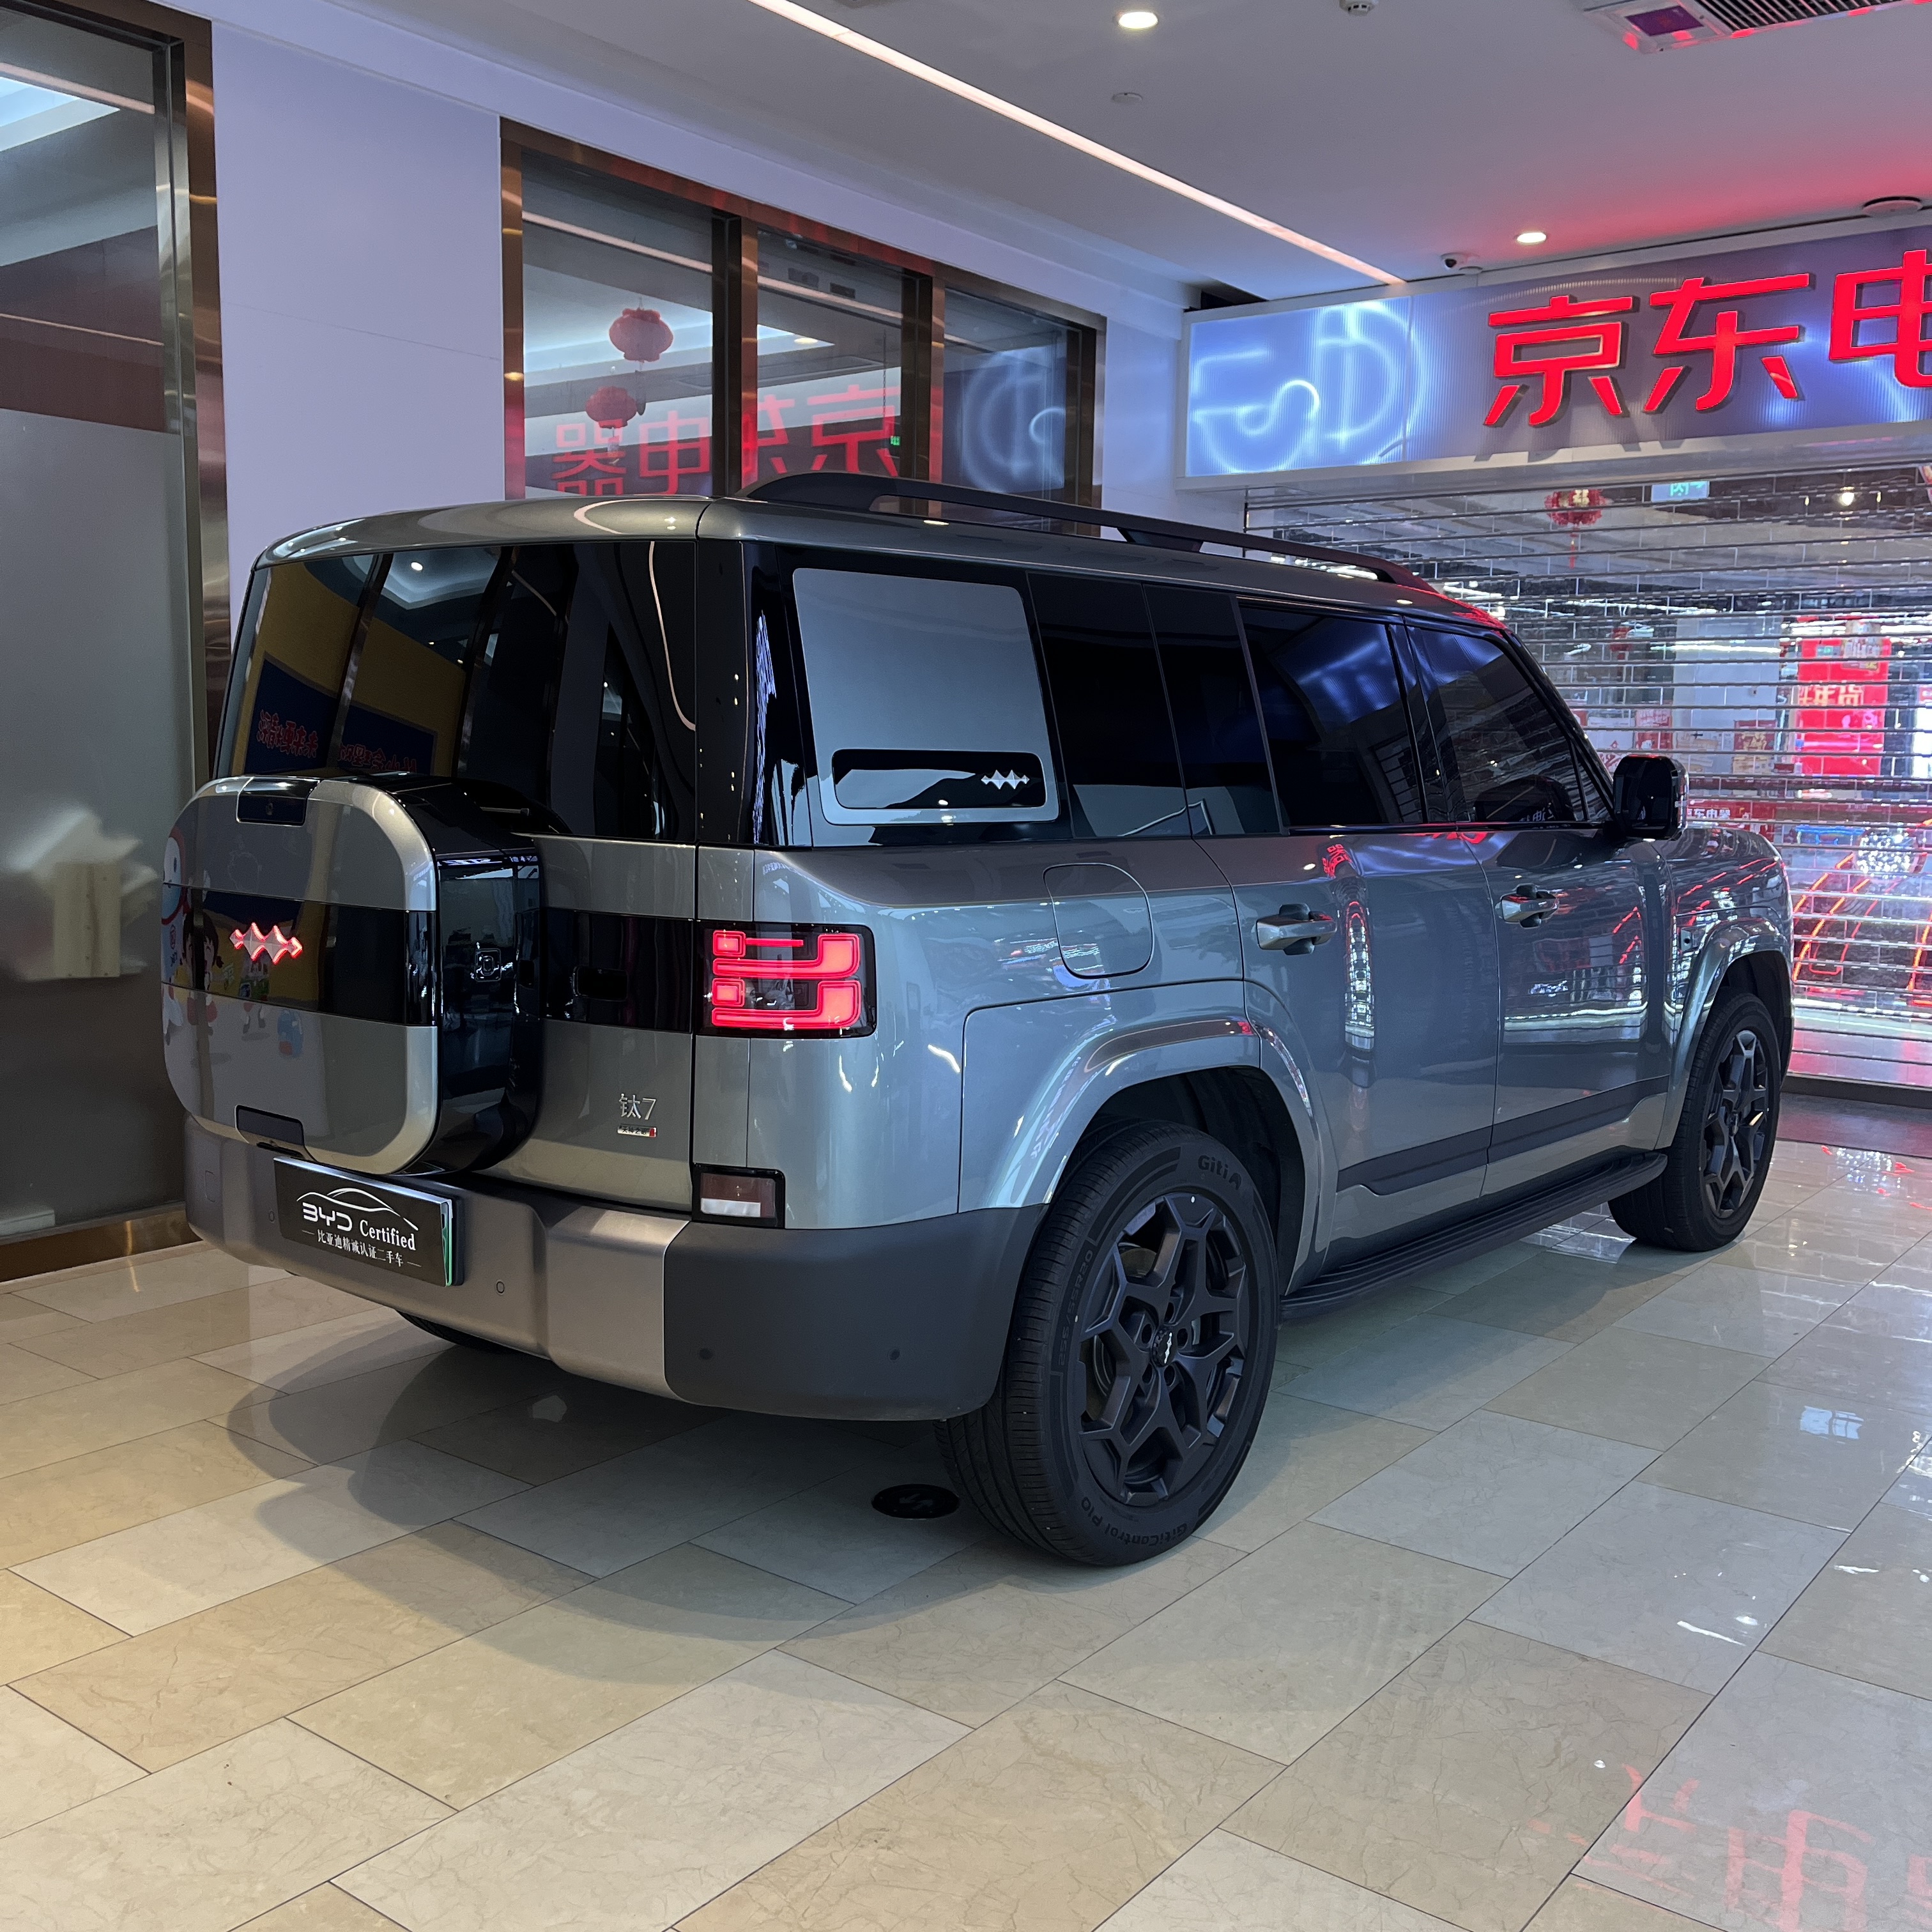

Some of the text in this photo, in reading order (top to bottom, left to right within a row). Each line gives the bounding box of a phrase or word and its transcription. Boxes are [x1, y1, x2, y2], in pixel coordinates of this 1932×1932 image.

[1483, 249, 1932, 425] 京东电
[618, 1093, 656, 1120] 钛7
[302, 1202, 416, 1251] BYD Certified
[317, 1229, 404, 1268] 比亚迪精诚认证二手车
